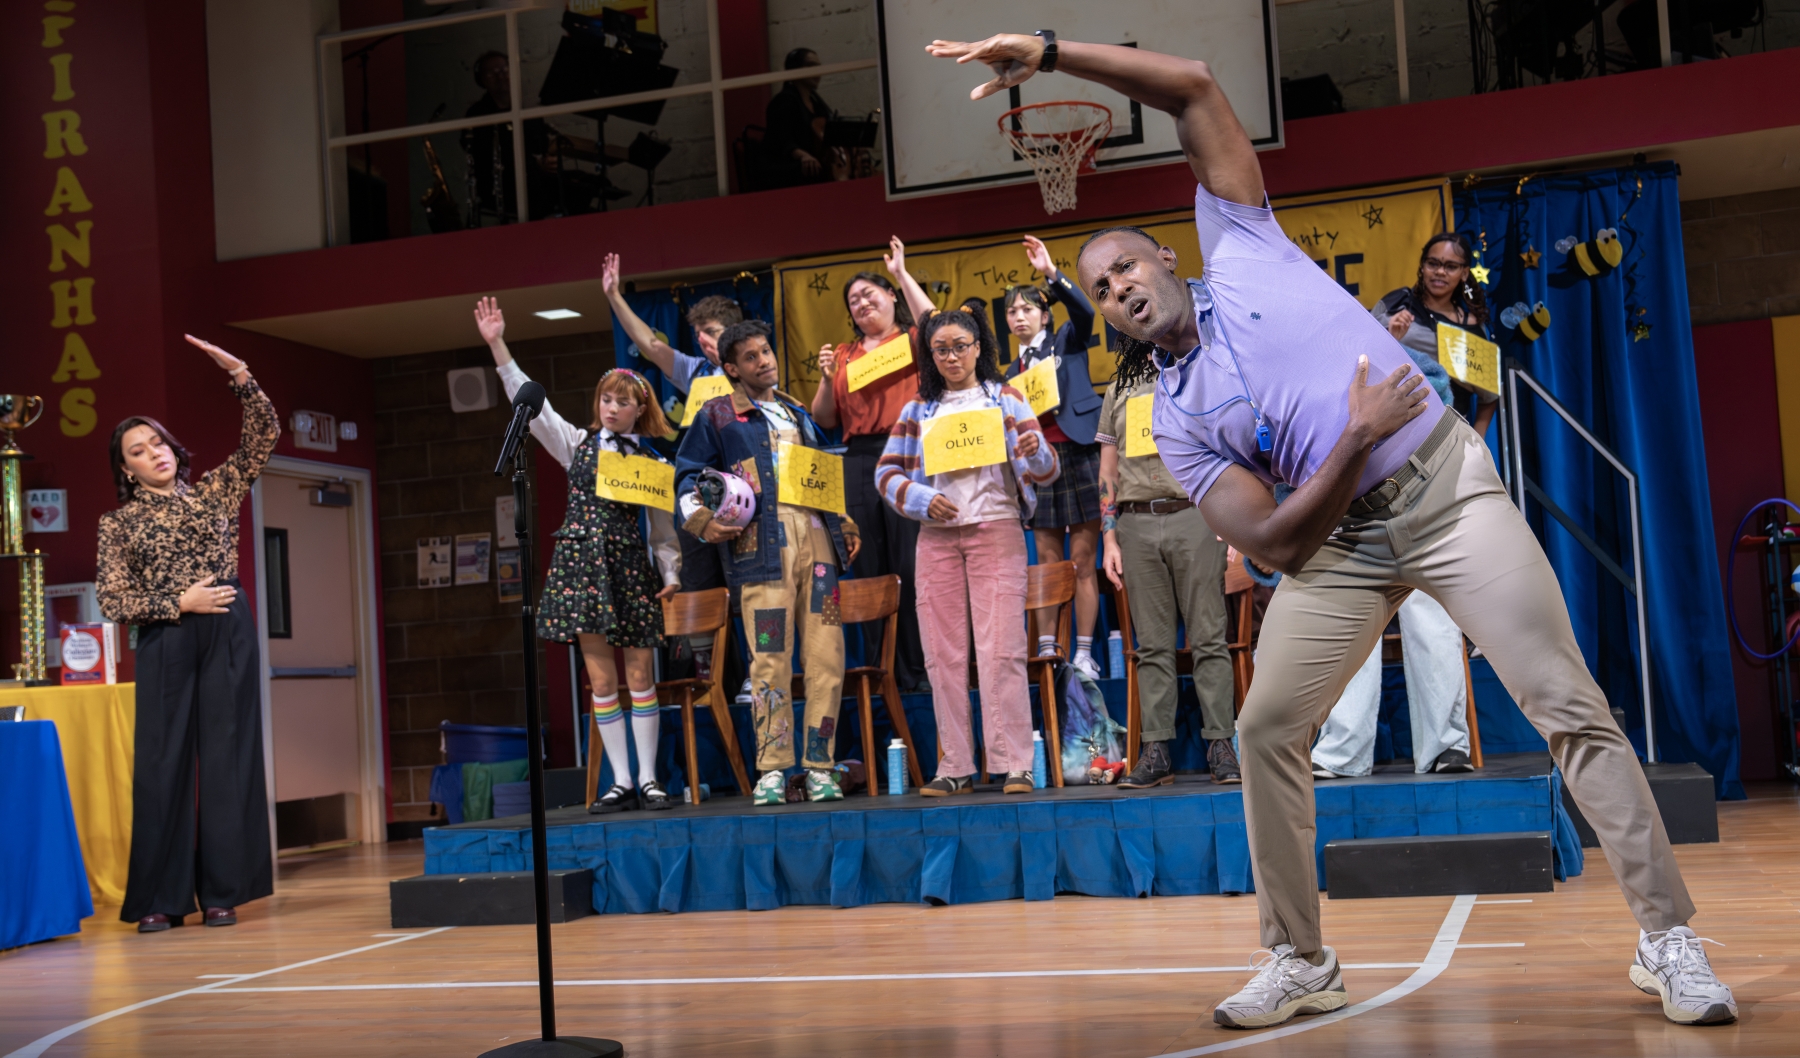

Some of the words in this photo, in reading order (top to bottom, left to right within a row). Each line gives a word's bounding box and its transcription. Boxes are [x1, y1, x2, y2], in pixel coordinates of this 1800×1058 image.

[973, 266, 1019, 286] The
[1028, 257, 1072, 282] 2th
[1286, 226, 1339, 250] nty
[1464, 347, 1475, 358] 23
[1455, 356, 1483, 373] DANA
[1029, 387, 1046, 404] RCY
[959, 422, 968, 434] 3
[945, 435, 985, 450] OLIVE
[634, 470, 641, 479] 1
[810, 463, 818, 475] 2
[604, 477, 669, 498] LOGAINNE
[800, 477, 827, 491] LEAF
[31, 492, 60, 503] AED
